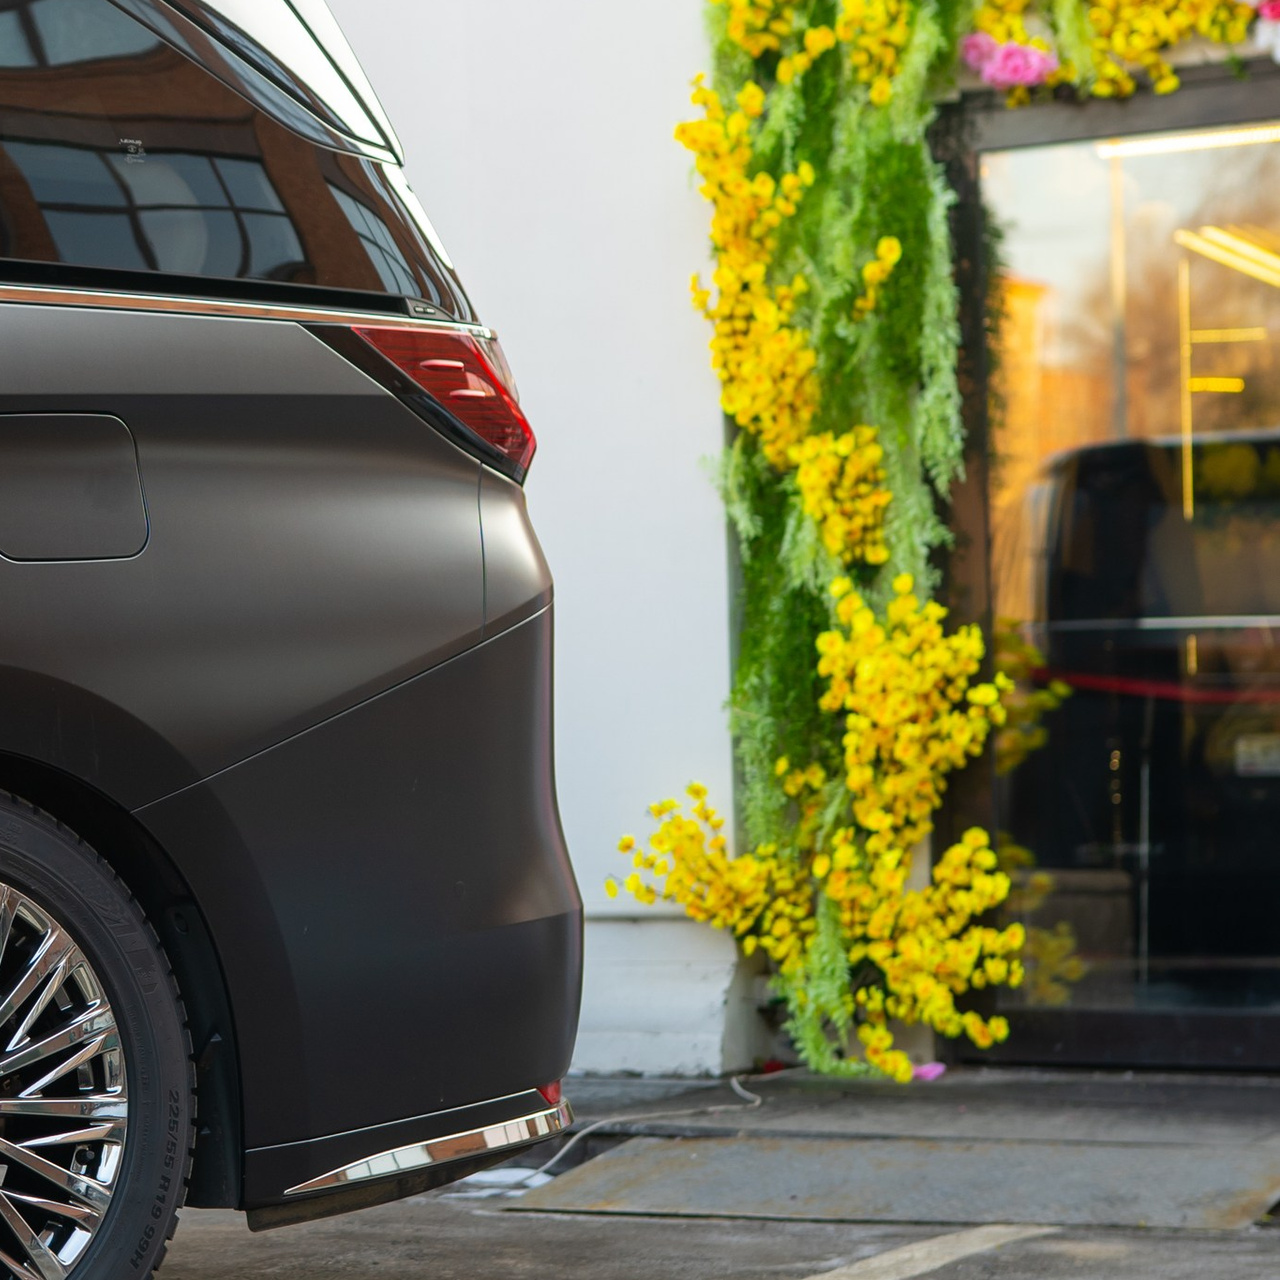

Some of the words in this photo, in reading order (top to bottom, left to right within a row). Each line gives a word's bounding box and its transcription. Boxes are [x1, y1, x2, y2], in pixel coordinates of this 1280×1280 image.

[164, 1088, 180, 1169] 225/55
[150, 1173, 171, 1221] R19
[129, 1222, 156, 1269] 99H
